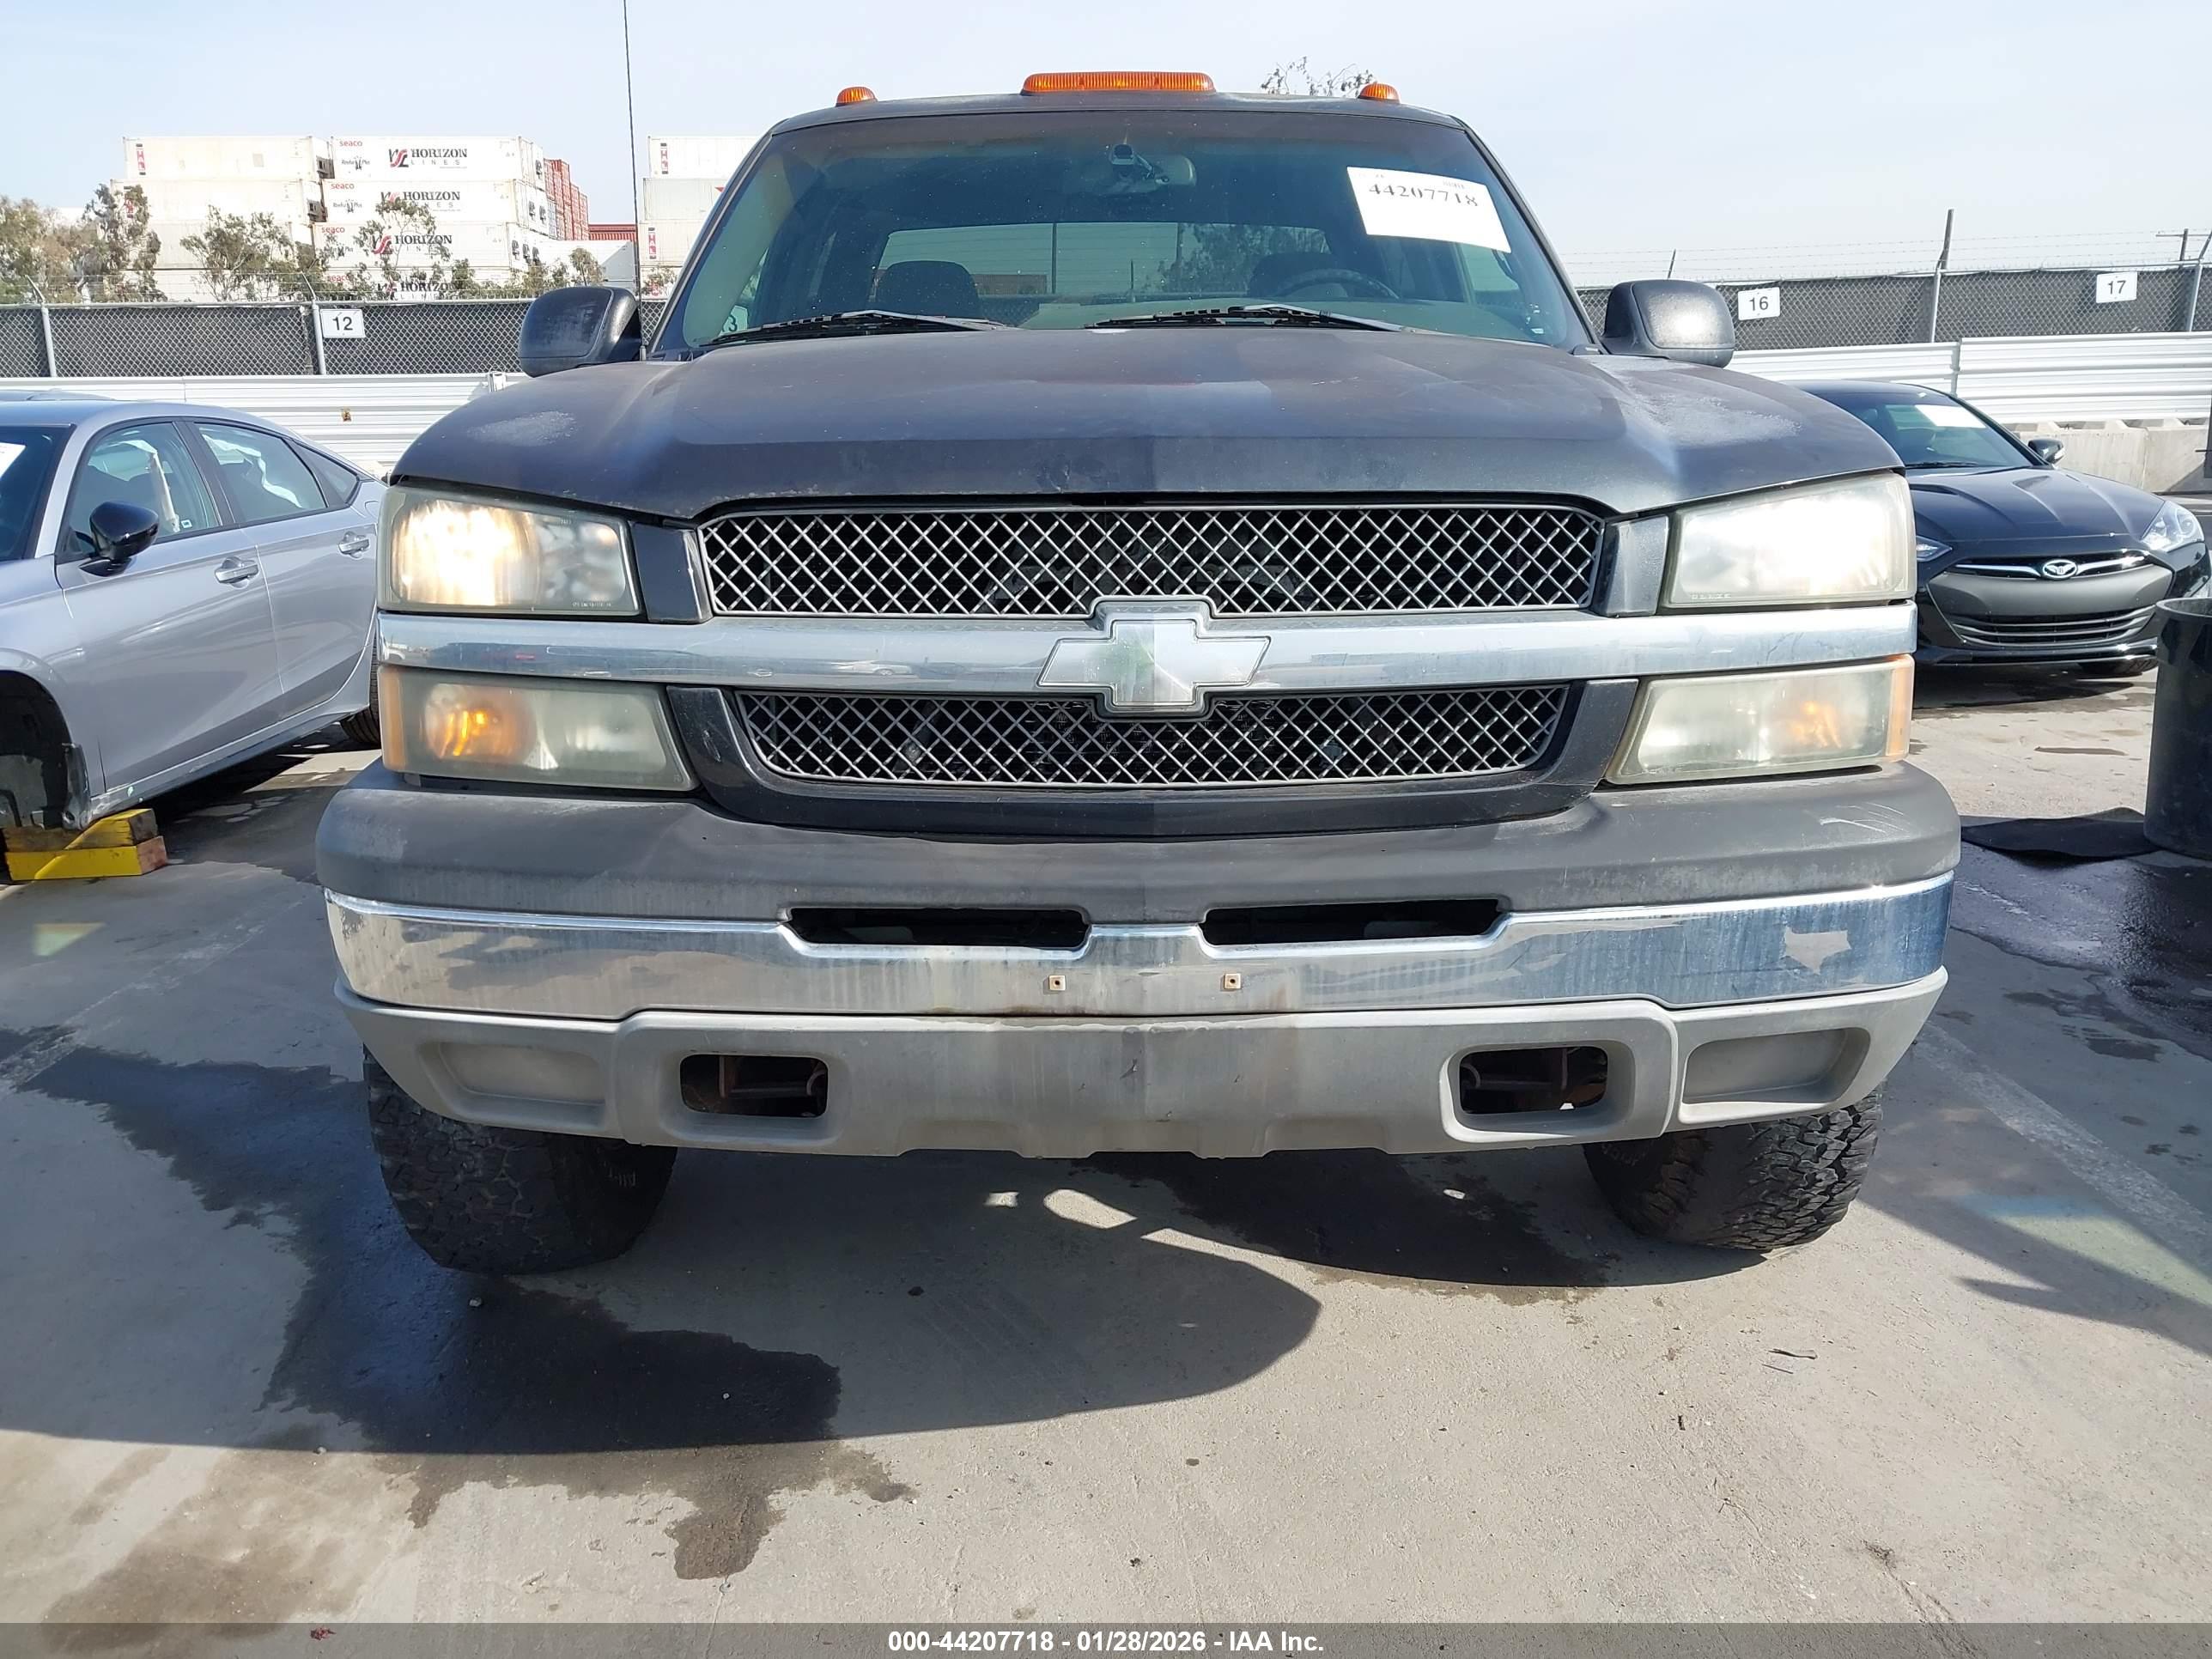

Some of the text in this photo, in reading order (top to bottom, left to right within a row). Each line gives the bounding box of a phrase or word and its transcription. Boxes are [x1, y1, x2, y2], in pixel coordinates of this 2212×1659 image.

[410, 149, 467, 158] HORIZON
[403, 191, 461, 201] HORIZON
[1369, 183, 1478, 207] 44207718
[395, 234, 453, 245] HORIZON
[2107, 280, 2127, 295] 17
[1749, 295, 1769, 312] 16
[332, 315, 354, 331] 12
